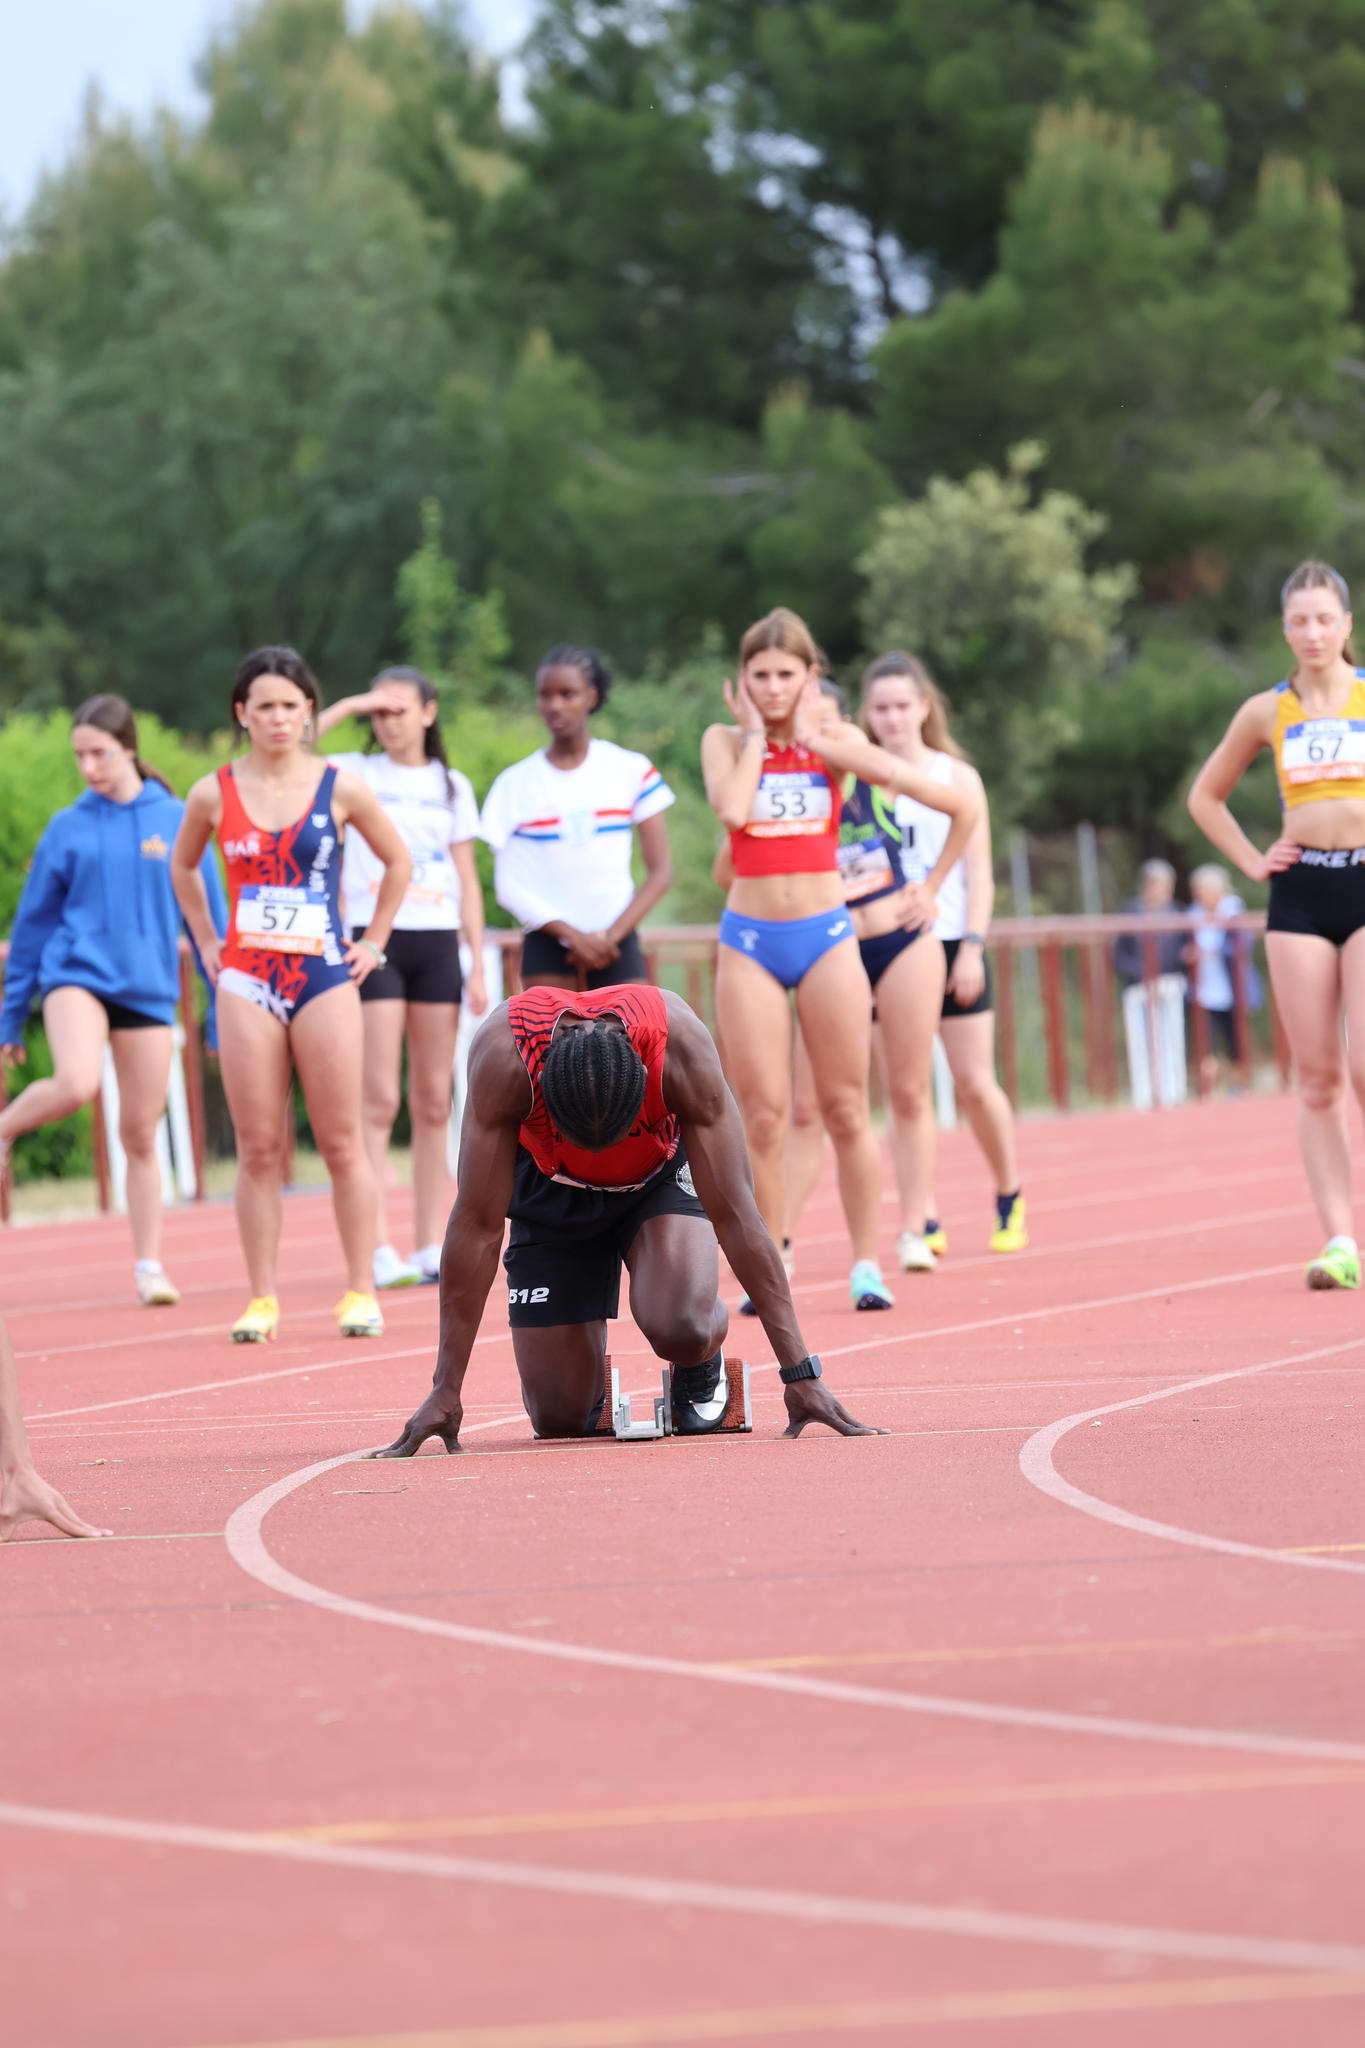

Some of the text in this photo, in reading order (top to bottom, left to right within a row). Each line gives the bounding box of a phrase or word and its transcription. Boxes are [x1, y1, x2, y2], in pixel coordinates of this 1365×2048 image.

[1309, 737, 1343, 762] 67
[771, 792, 806, 818] 53
[262, 905, 299, 931] 57
[509, 1287, 550, 1304] 512
